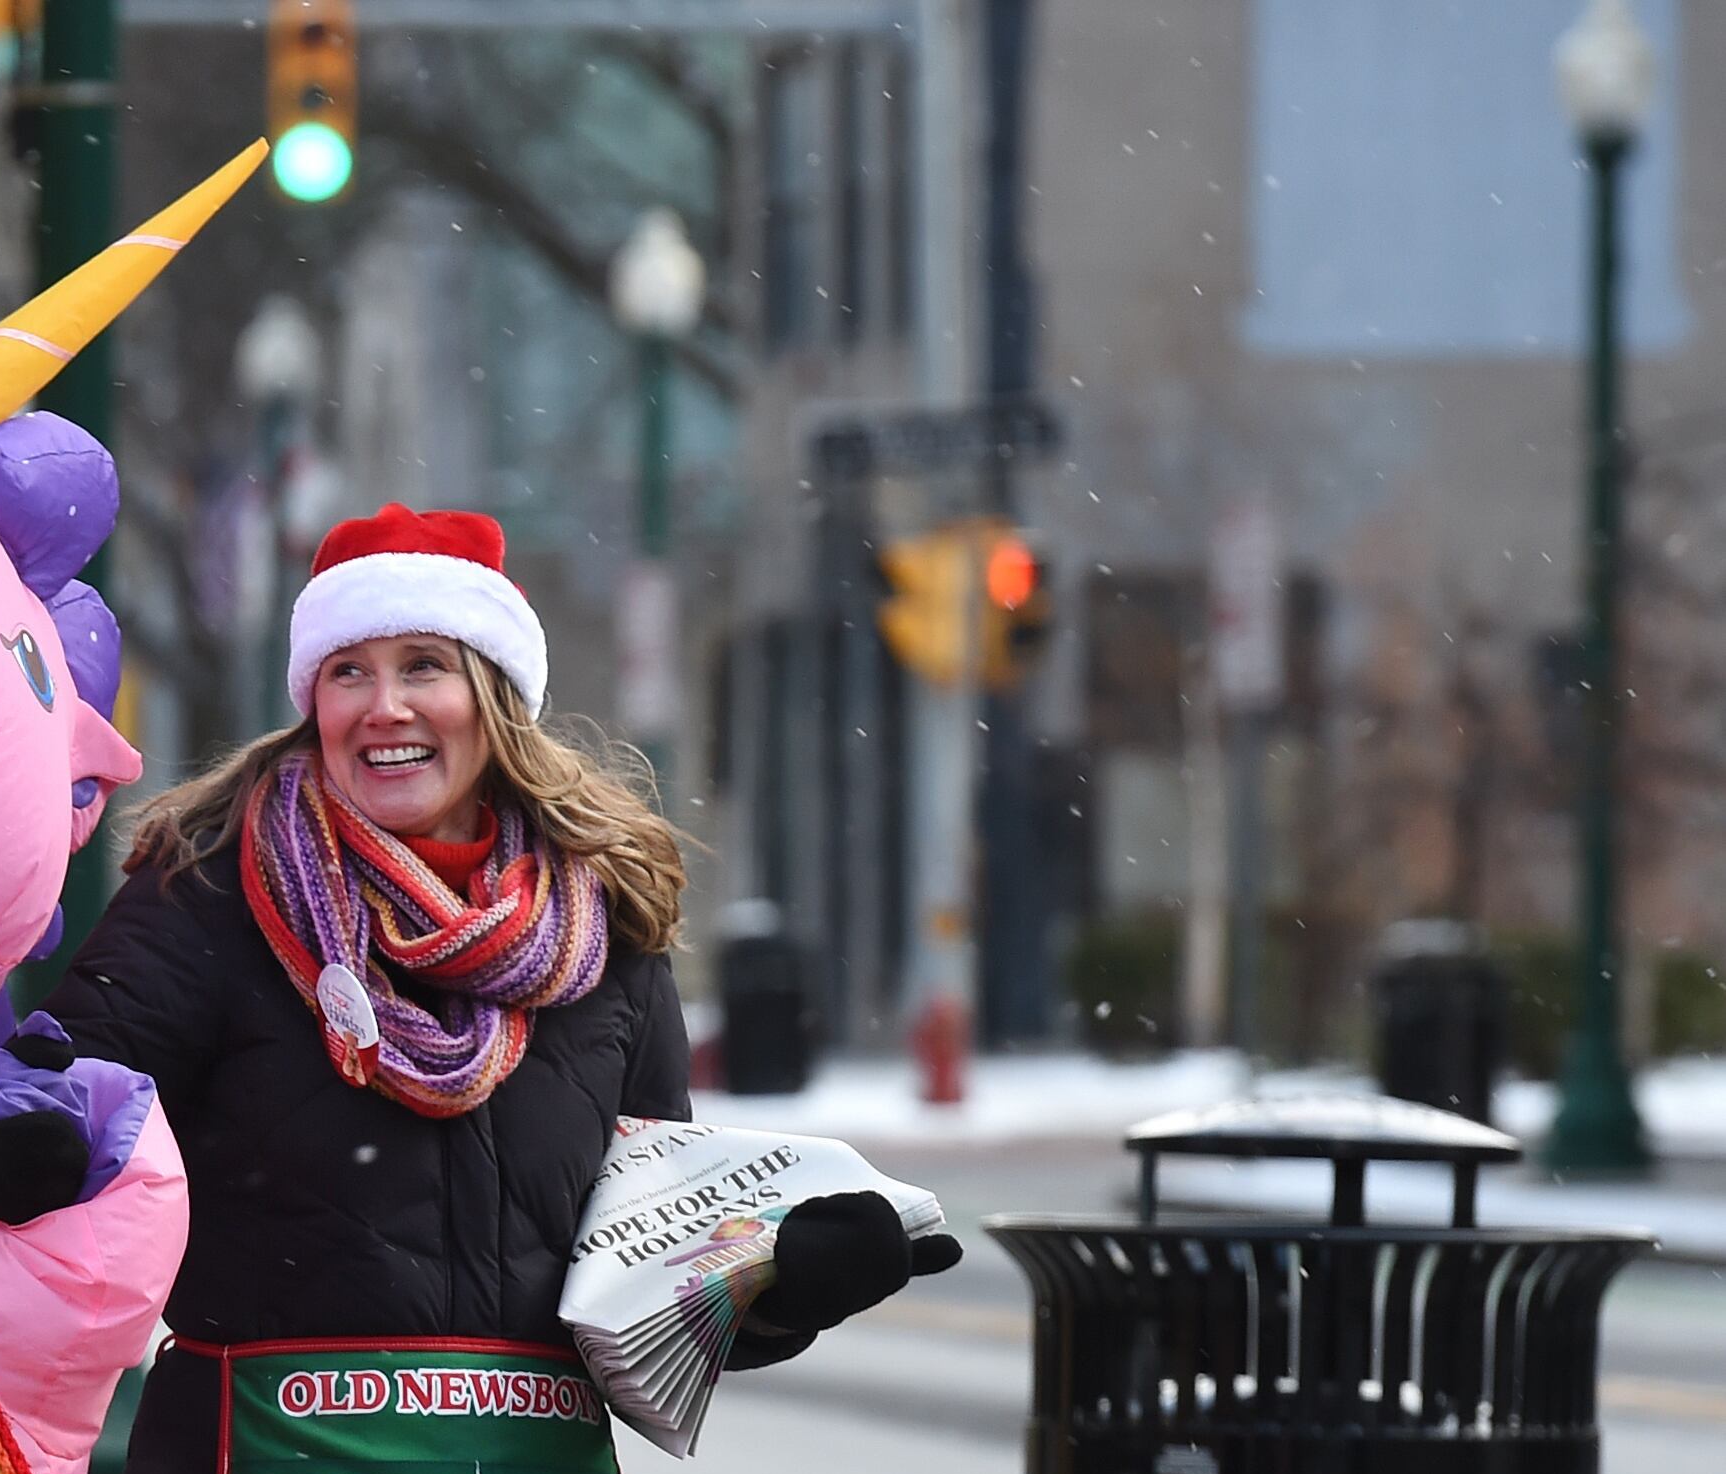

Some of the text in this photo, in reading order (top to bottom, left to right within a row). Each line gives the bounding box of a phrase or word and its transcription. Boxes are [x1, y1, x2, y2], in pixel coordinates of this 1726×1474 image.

[628, 1196, 641, 1207] the
[642, 1180, 686, 1200] Christmas
[685, 1157, 731, 1182] fundraiser
[653, 1184, 728, 1225] FOR
[722, 1144, 802, 1192] THE
[277, 1368, 390, 1418] OLD
